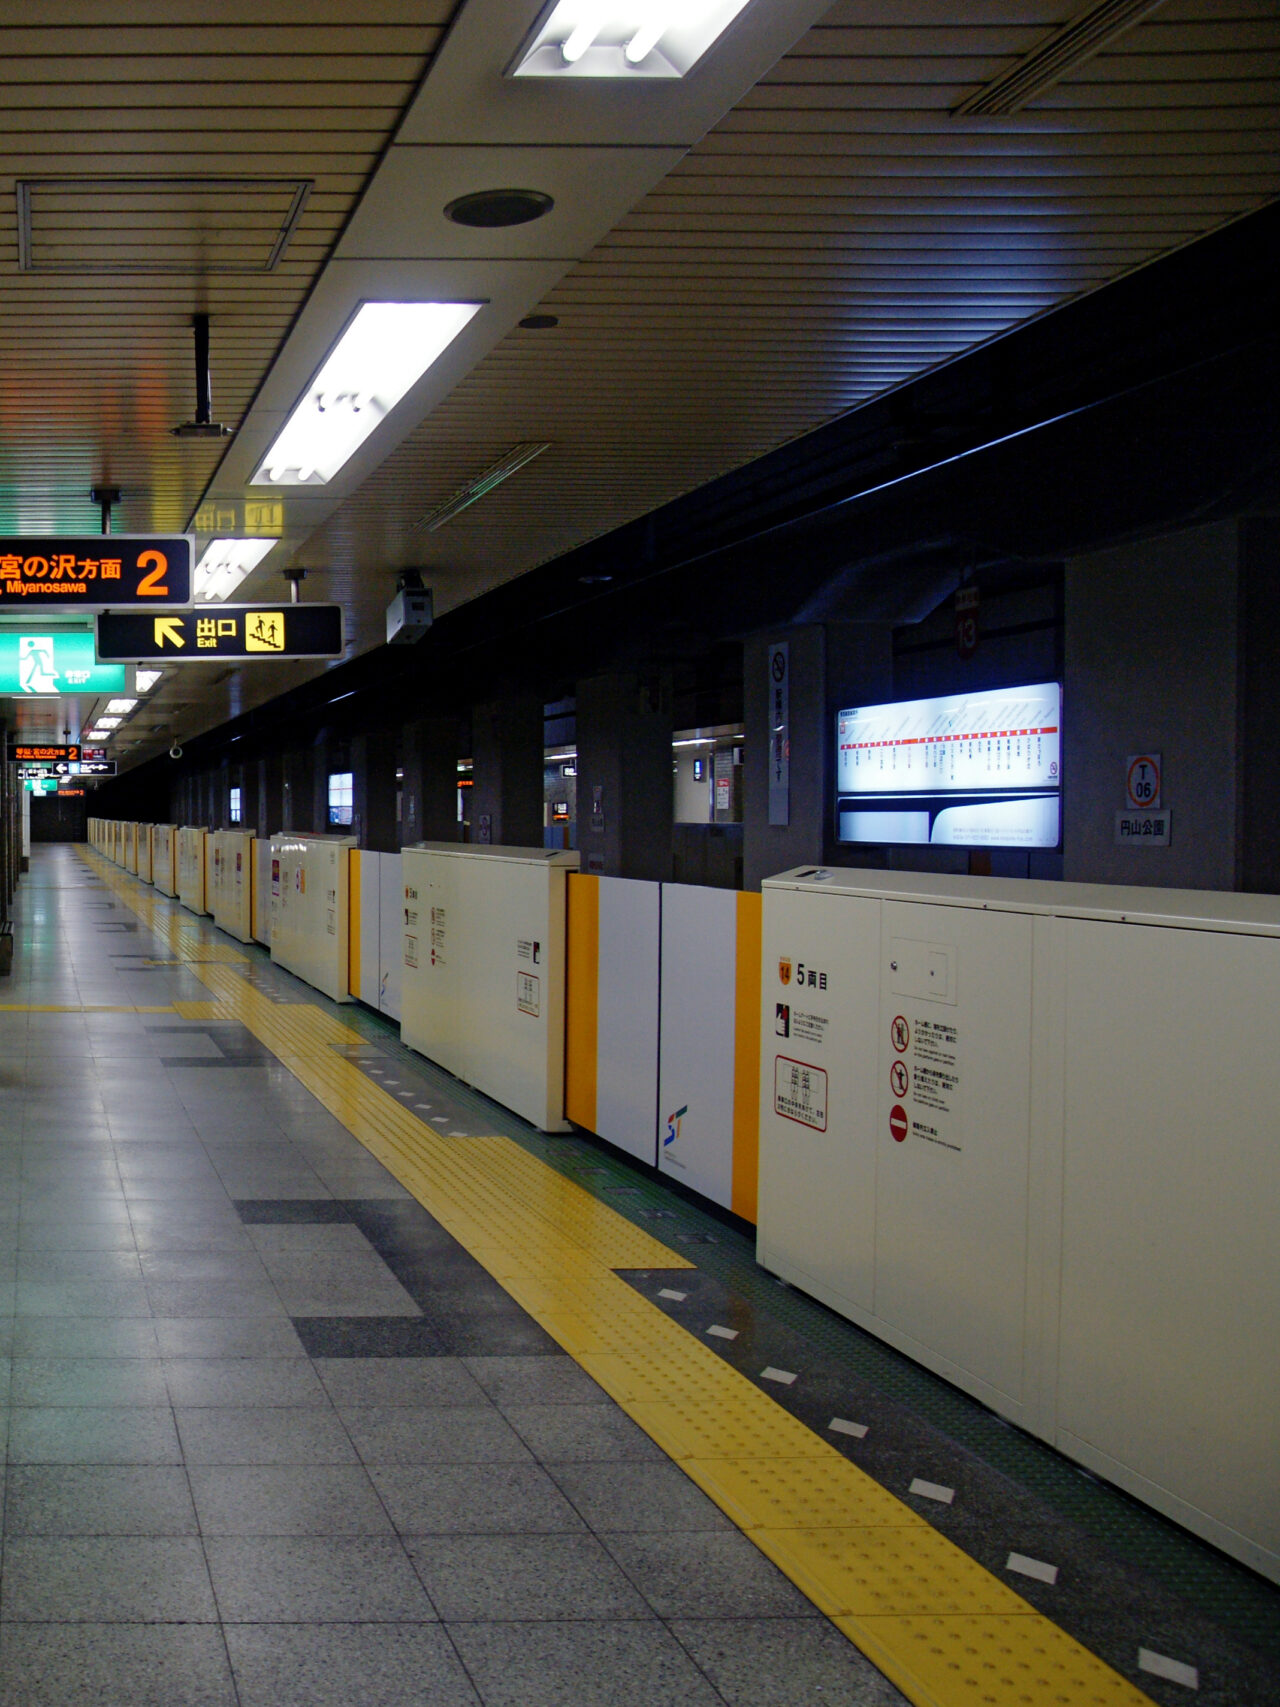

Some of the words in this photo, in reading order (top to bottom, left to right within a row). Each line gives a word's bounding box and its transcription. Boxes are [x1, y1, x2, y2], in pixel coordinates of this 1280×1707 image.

[136, 550, 169, 596] 2
[7, 581, 86, 596] Miyanosawa
[197, 618, 236, 637] 出口
[197, 637, 217, 648] Exit
[68, 747, 77, 760] 2
[1140, 764, 1147, 780] T
[1136, 782, 1151, 798] 06
[1120, 819, 1165, 836] 円山公園
[797, 963, 827, 990] 5両目
